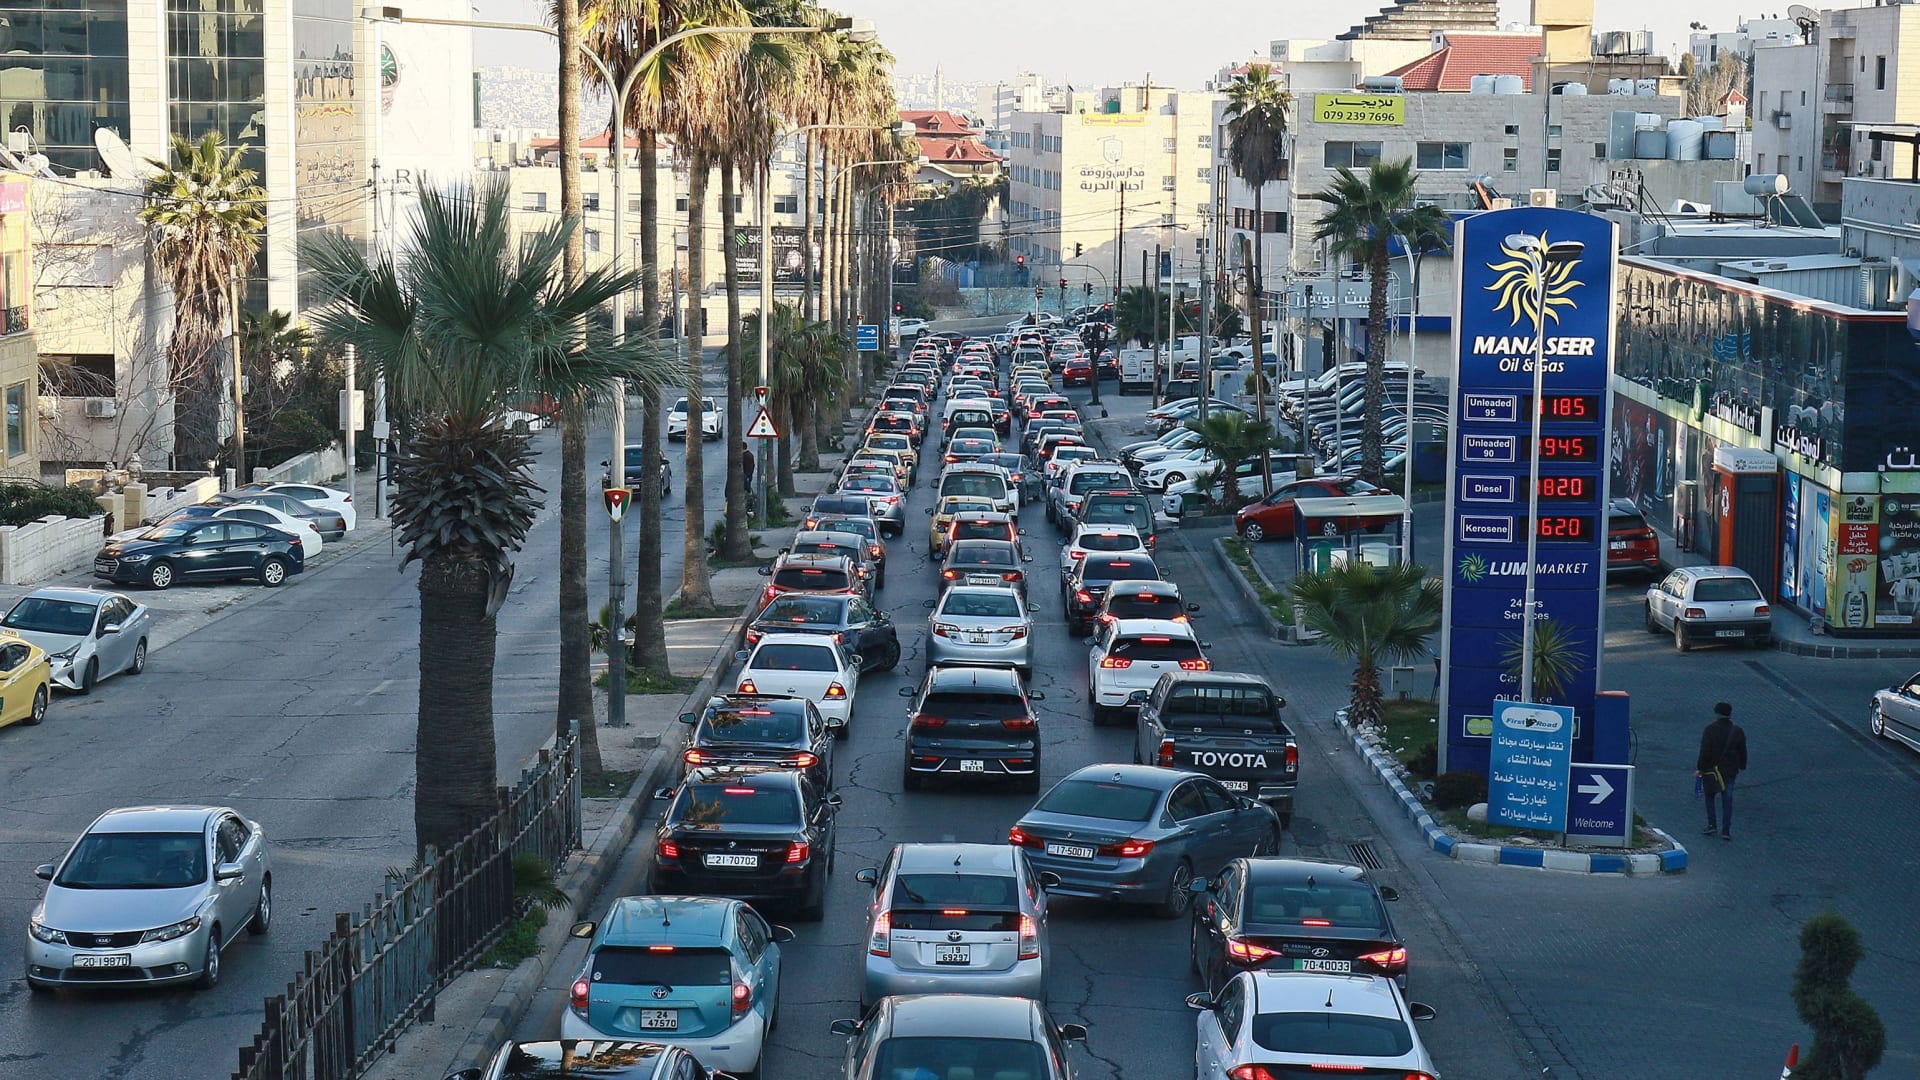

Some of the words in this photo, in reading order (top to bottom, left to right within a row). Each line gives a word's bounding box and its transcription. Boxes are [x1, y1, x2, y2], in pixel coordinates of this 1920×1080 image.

[1327, 98, 1393, 109] للإيجار
[1323, 111, 1344, 120] 079
[1346, 112, 1366, 121] 239
[1369, 113, 1395, 122] 7696
[1499, 358, 1519, 372] Oil
[1522, 359, 1535, 372] &
[1470, 398, 1512, 407] Unleaded
[1468, 439, 1510, 448] Unleaded
[1474, 484, 1502, 493] Diesel
[1465, 524, 1508, 533] Kerosene
[1536, 563, 1588, 574] MARKET
[1510, 599, 1522, 608] 24
[1506, 717, 1525, 725] First
[1535, 719, 1558, 728] Road
[1191, 751, 1267, 768] TOYOTA
[1575, 818, 1615, 829] Welcome
[657, 1011, 667, 1019] 24
[648, 1019, 677, 1027] 47570
